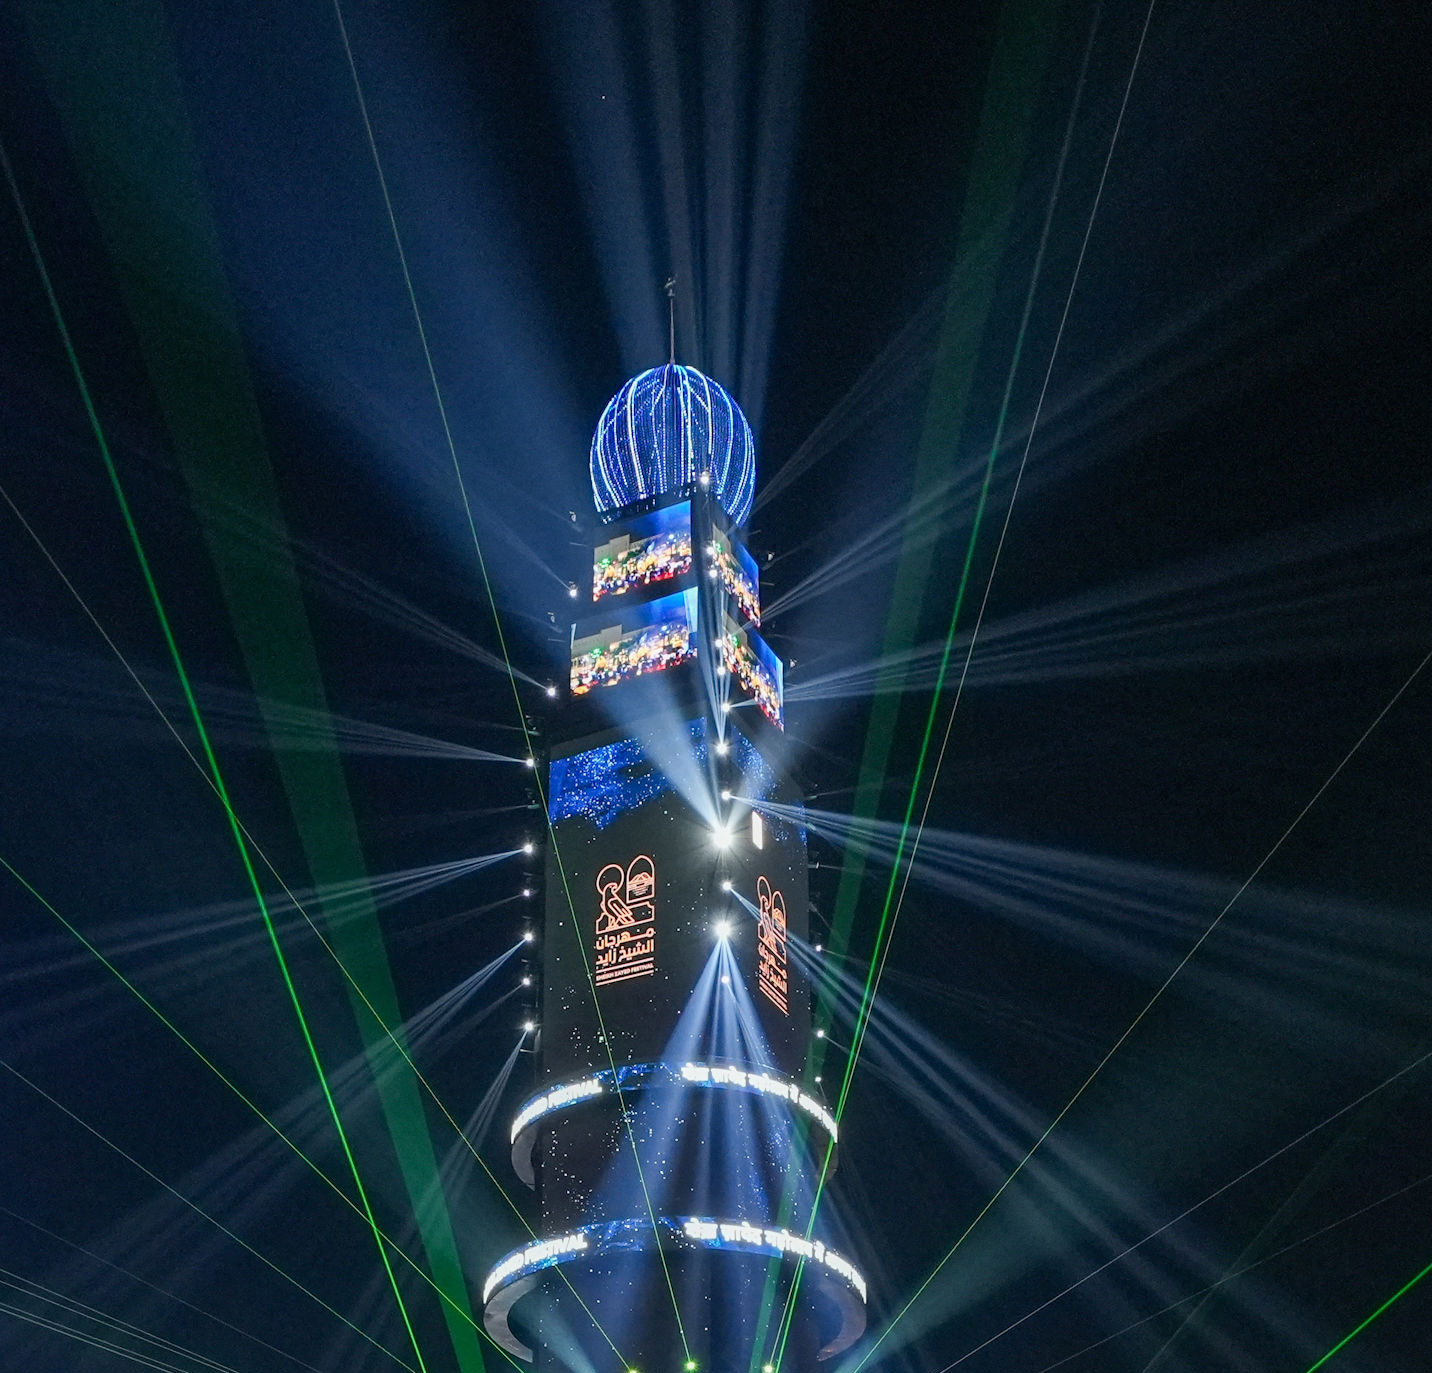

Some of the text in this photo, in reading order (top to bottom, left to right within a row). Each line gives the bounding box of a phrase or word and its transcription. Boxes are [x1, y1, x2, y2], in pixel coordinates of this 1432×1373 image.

[596, 927, 655, 950] مهرجان
[596, 939, 655, 967] الشيخ زايد
